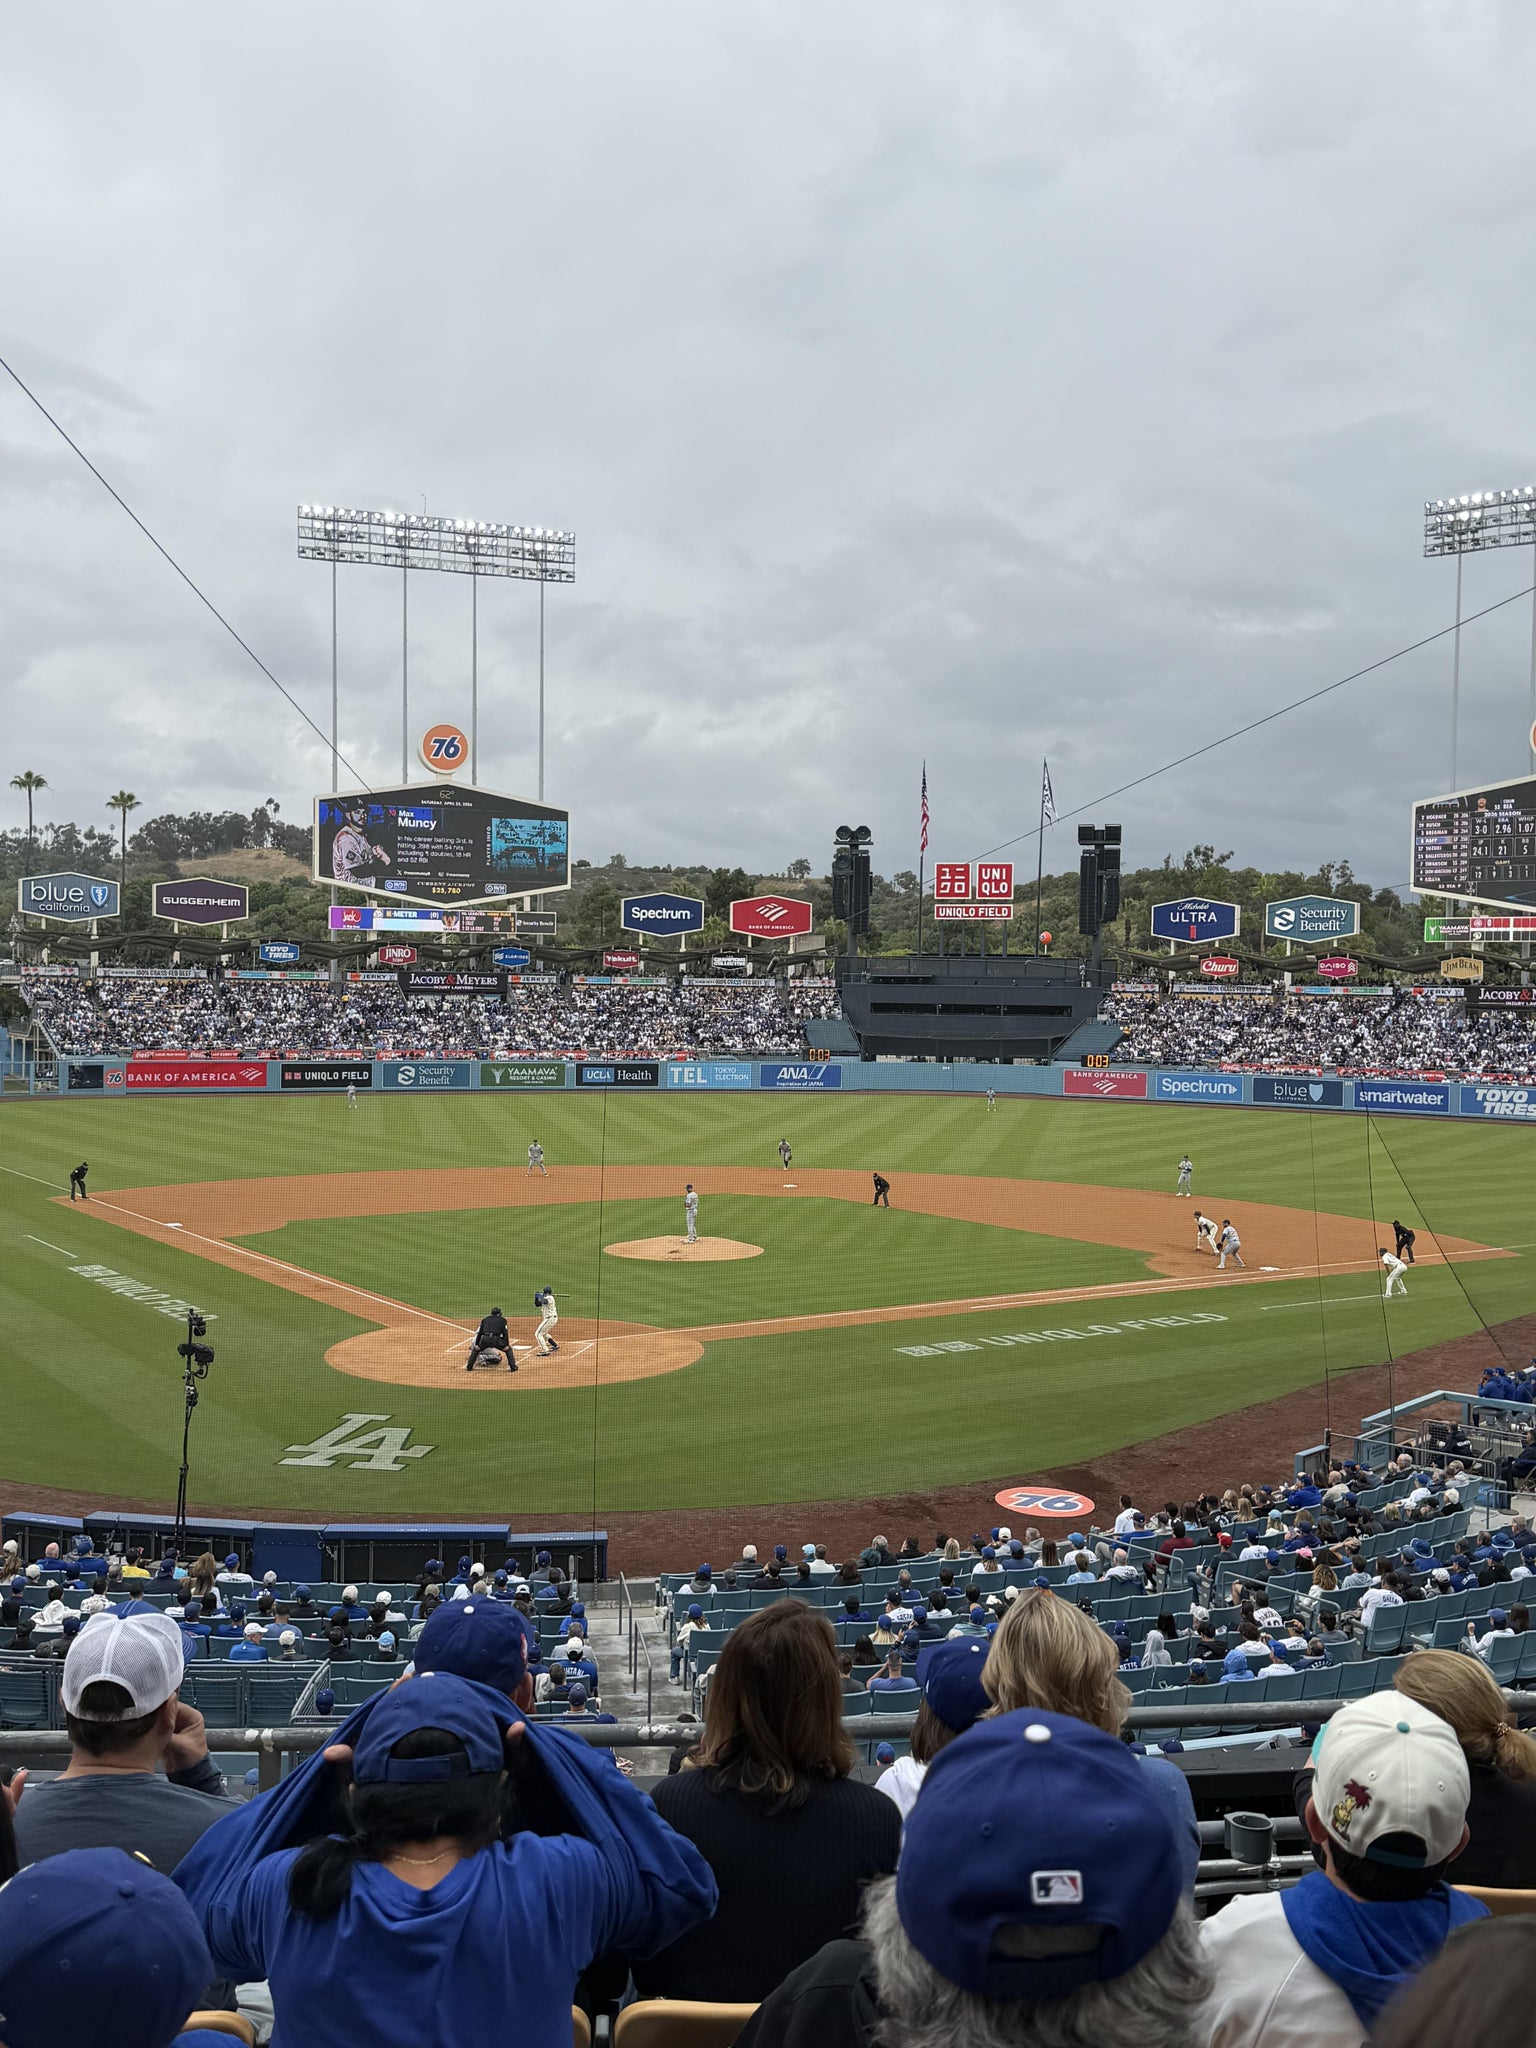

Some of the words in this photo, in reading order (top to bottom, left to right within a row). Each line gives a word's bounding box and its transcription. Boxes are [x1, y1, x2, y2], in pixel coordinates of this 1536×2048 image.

[430, 735, 462, 760] 76
[398, 817, 437, 830] Muncy
[1475, 825, 1487, 834] 3-0
[1496, 824, 1511, 834] 2.96
[1519, 823, 1534, 833] 1.07
[1473, 846, 1488, 856] 24.1
[1498, 846, 1506, 855] 21
[1523, 845, 1528, 854] 5
[982, 868, 1006, 879] UNI
[31, 881, 84, 902] blue
[982, 881, 1008, 896] QLO
[162, 896, 241, 906] GUGGENHEIM
[39, 903, 90, 913] california
[939, 908, 975, 918] UNIQLO
[978, 908, 1008, 916] FIELD
[1300, 907, 1348, 921] Security
[343, 911, 361, 922] Jack
[631, 907, 691, 922] Spectrum
[1170, 911, 1217, 923] ULTRA
[1300, 920, 1342, 931] Benefit
[385, 949, 411, 960] JINRO
[1202, 961, 1238, 973] Churu
[1444, 962, 1458, 974] JIM
[1459, 959, 1480, 974] BEAM
[409, 974, 446, 985] JACOBY
[446, 974, 456, 985] &
[456, 974, 498, 985] MEYERS
[1478, 988, 1521, 1000] JACOBY
[1520, 989, 1530, 1000] &
[809, 1049, 830, 1061] 0:03
[1087, 1055, 1109, 1067] 0:03
[164, 1073, 180, 1081] OF
[182, 1072, 237, 1081] AMERICA
[305, 1072, 339, 1081] UNIQLO
[342, 1071, 369, 1080] FIELD
[419, 1066, 455, 1076] Security
[586, 1070, 611, 1080] UCLA
[617, 1070, 651, 1080] Health
[670, 1067, 707, 1084] TEL
[777, 1067, 807, 1080] ANA
[107, 1071, 123, 1084] 76
[419, 1076, 450, 1085] Benefit
[1162, 1078, 1232, 1095] Spectrum
[1274, 1082, 1307, 1097] blue
[1360, 1090, 1443, 1105] smartwater
[1476, 1089, 1528, 1103] TOYO
[1484, 1102, 1536, 1116] TIRES
[979, 1324, 1121, 1346] UNIQLO
[1120, 1313, 1229, 1330] FIELD
[276, 1412, 437, 1471] LA
[1007, 1492, 1084, 1512] 76
[564, 1668, 584, 1677] HTANI
